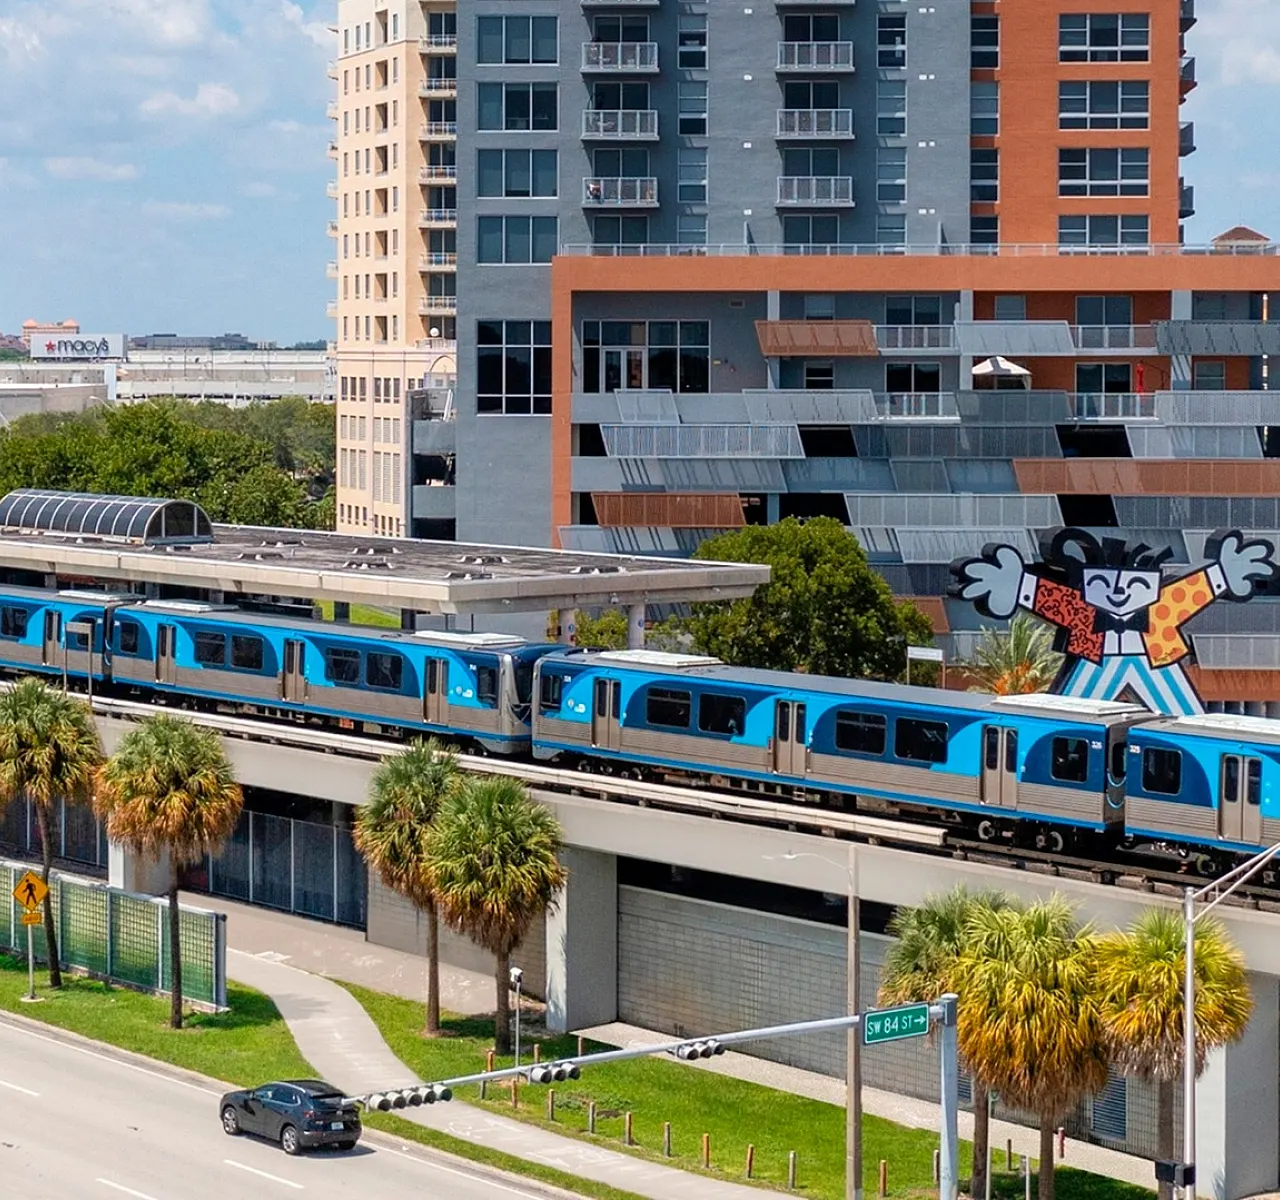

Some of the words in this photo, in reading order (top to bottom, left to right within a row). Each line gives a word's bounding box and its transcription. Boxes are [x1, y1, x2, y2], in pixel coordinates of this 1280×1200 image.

[57, 337, 109, 355] macy's
[867, 1020, 881, 1035] SW
[884, 1016, 899, 1033] 84
[901, 1015, 913, 1029] ST
